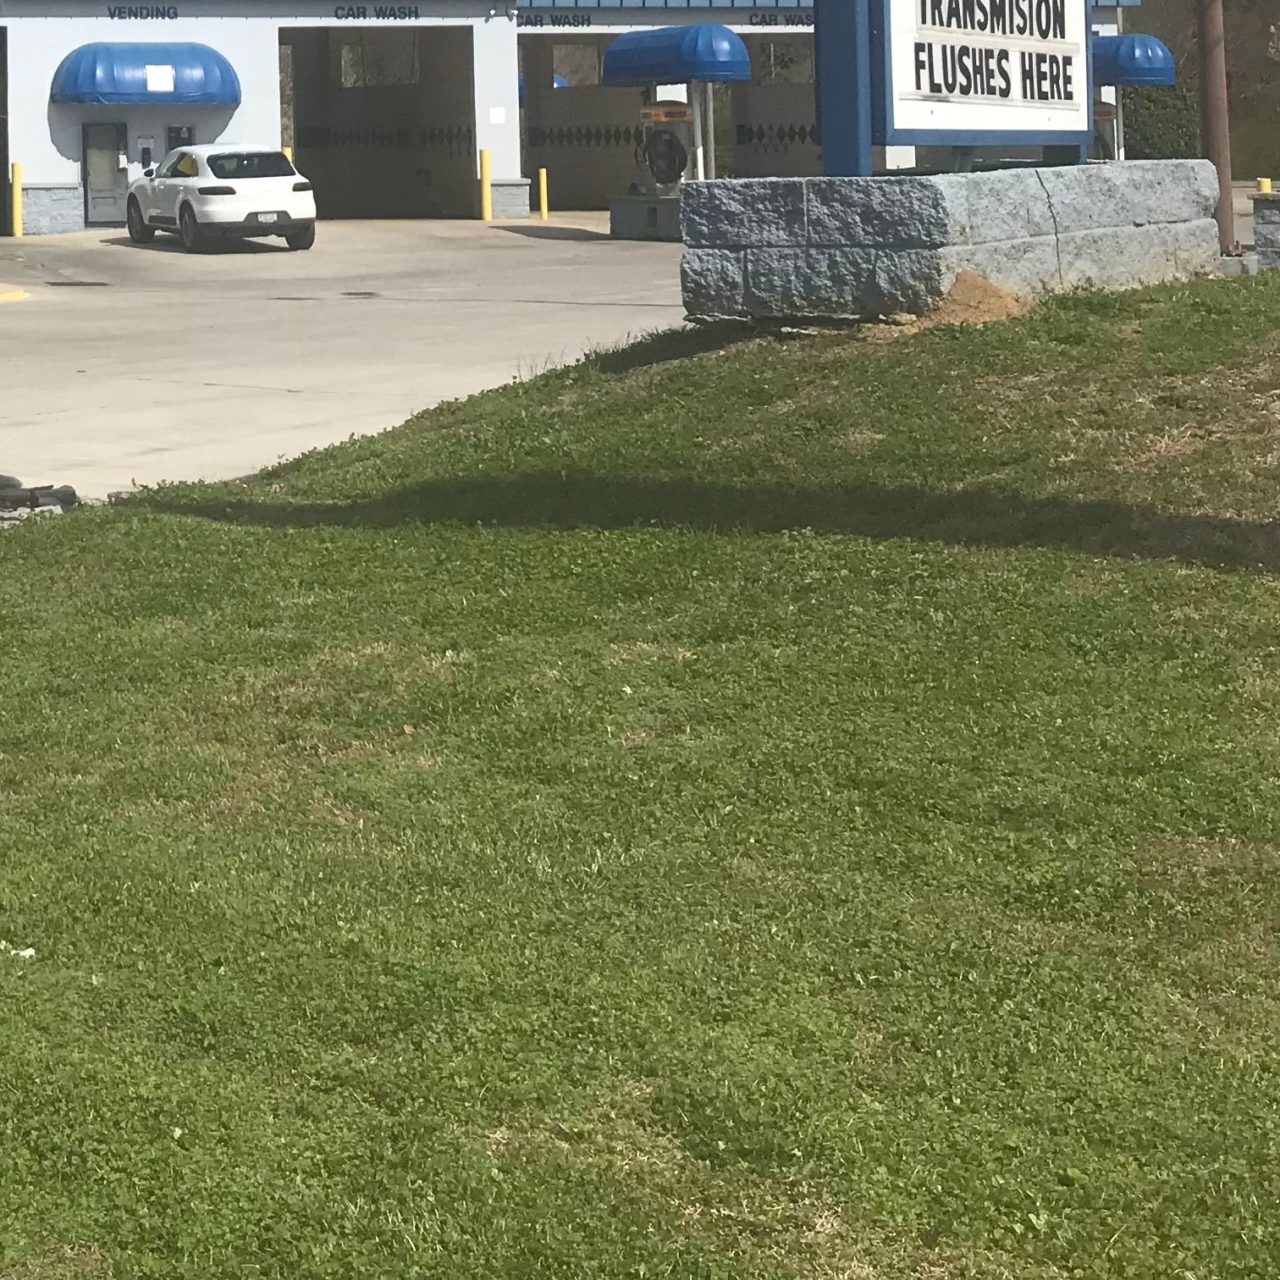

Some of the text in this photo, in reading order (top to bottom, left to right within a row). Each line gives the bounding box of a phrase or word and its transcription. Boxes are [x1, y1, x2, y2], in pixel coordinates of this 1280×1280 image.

[107, 6, 178, 20] VENDING
[334, 6, 419, 20] CAR WASH
[749, 13, 814, 27] CAR WAS
[550, 14, 591, 27] WASH
[914, 42, 1074, 102] FLUSHES HERE
